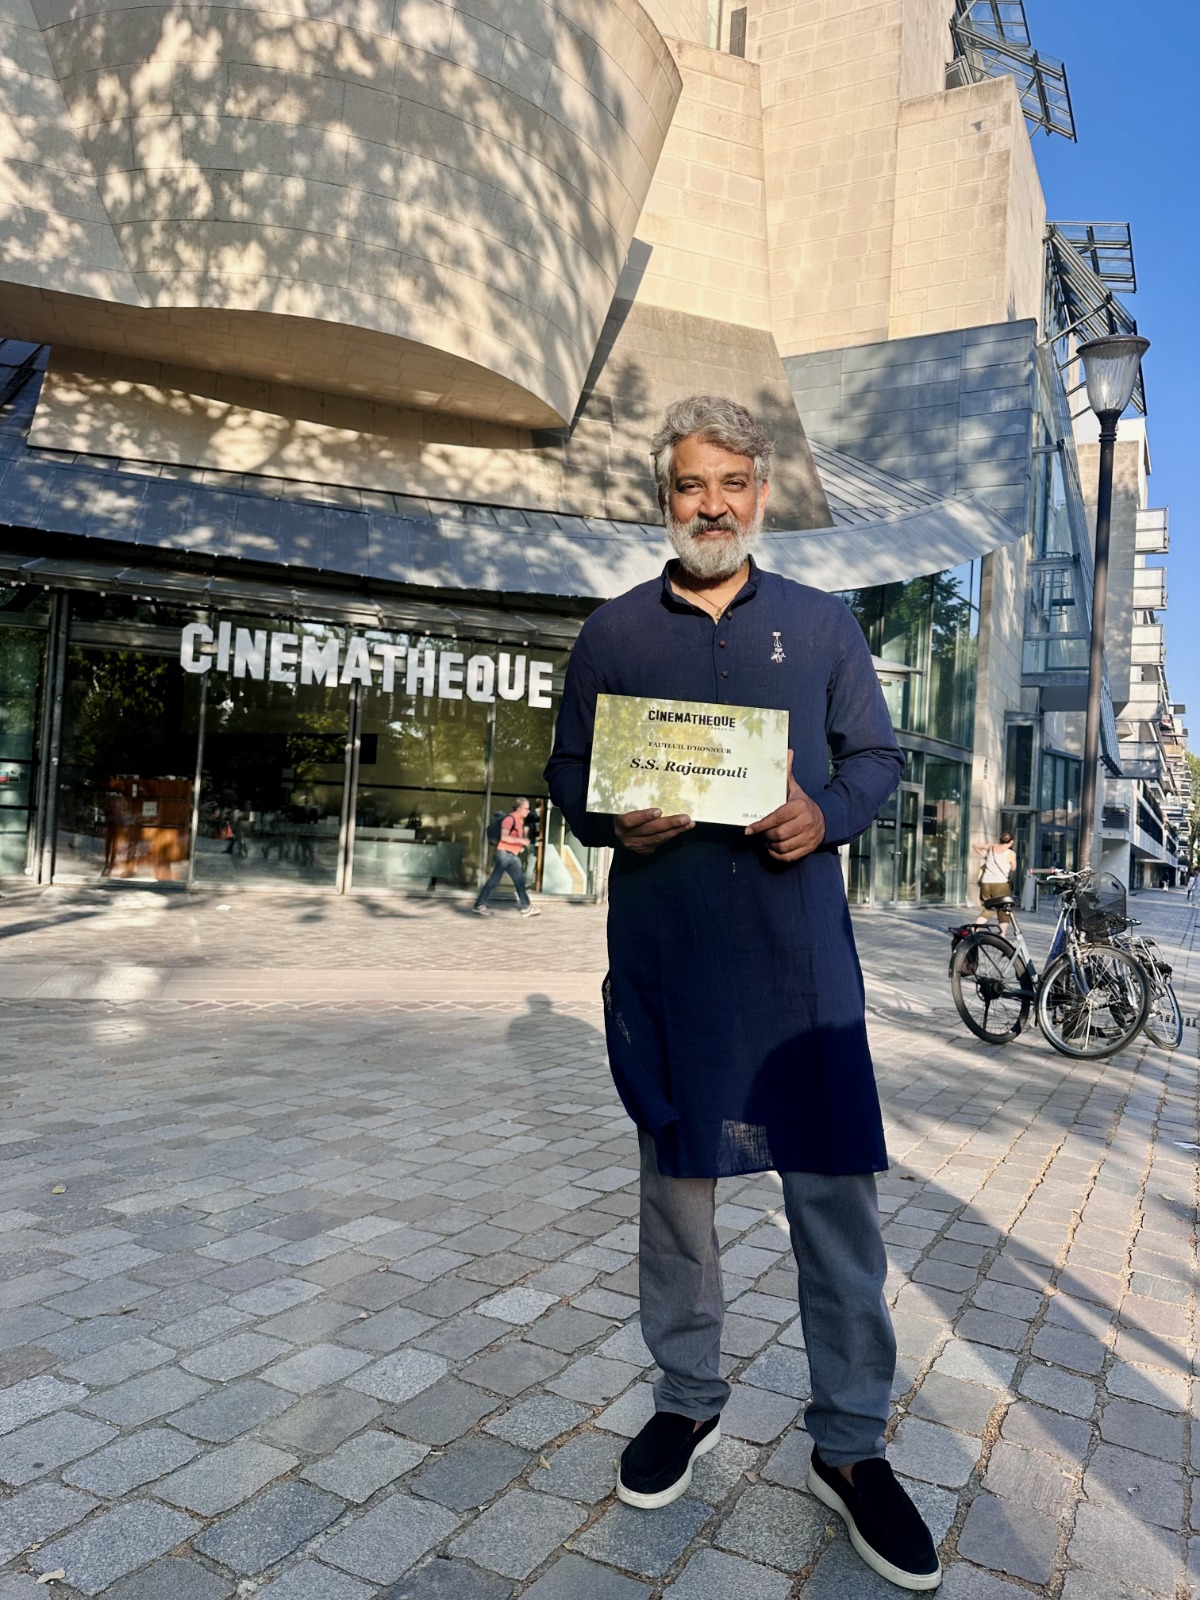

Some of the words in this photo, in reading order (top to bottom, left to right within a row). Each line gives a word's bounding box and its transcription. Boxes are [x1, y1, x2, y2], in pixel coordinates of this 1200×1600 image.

[180, 621, 553, 709] CINEMATHEQUE
[648, 710, 736, 728] CINEMATHEQUE
[648, 741, 685, 750] FAUTEUIL
[686, 745, 732, 754] D'HONNEUR
[629, 758, 659, 771] S.S.
[664, 760, 748, 779] Rajamouli
